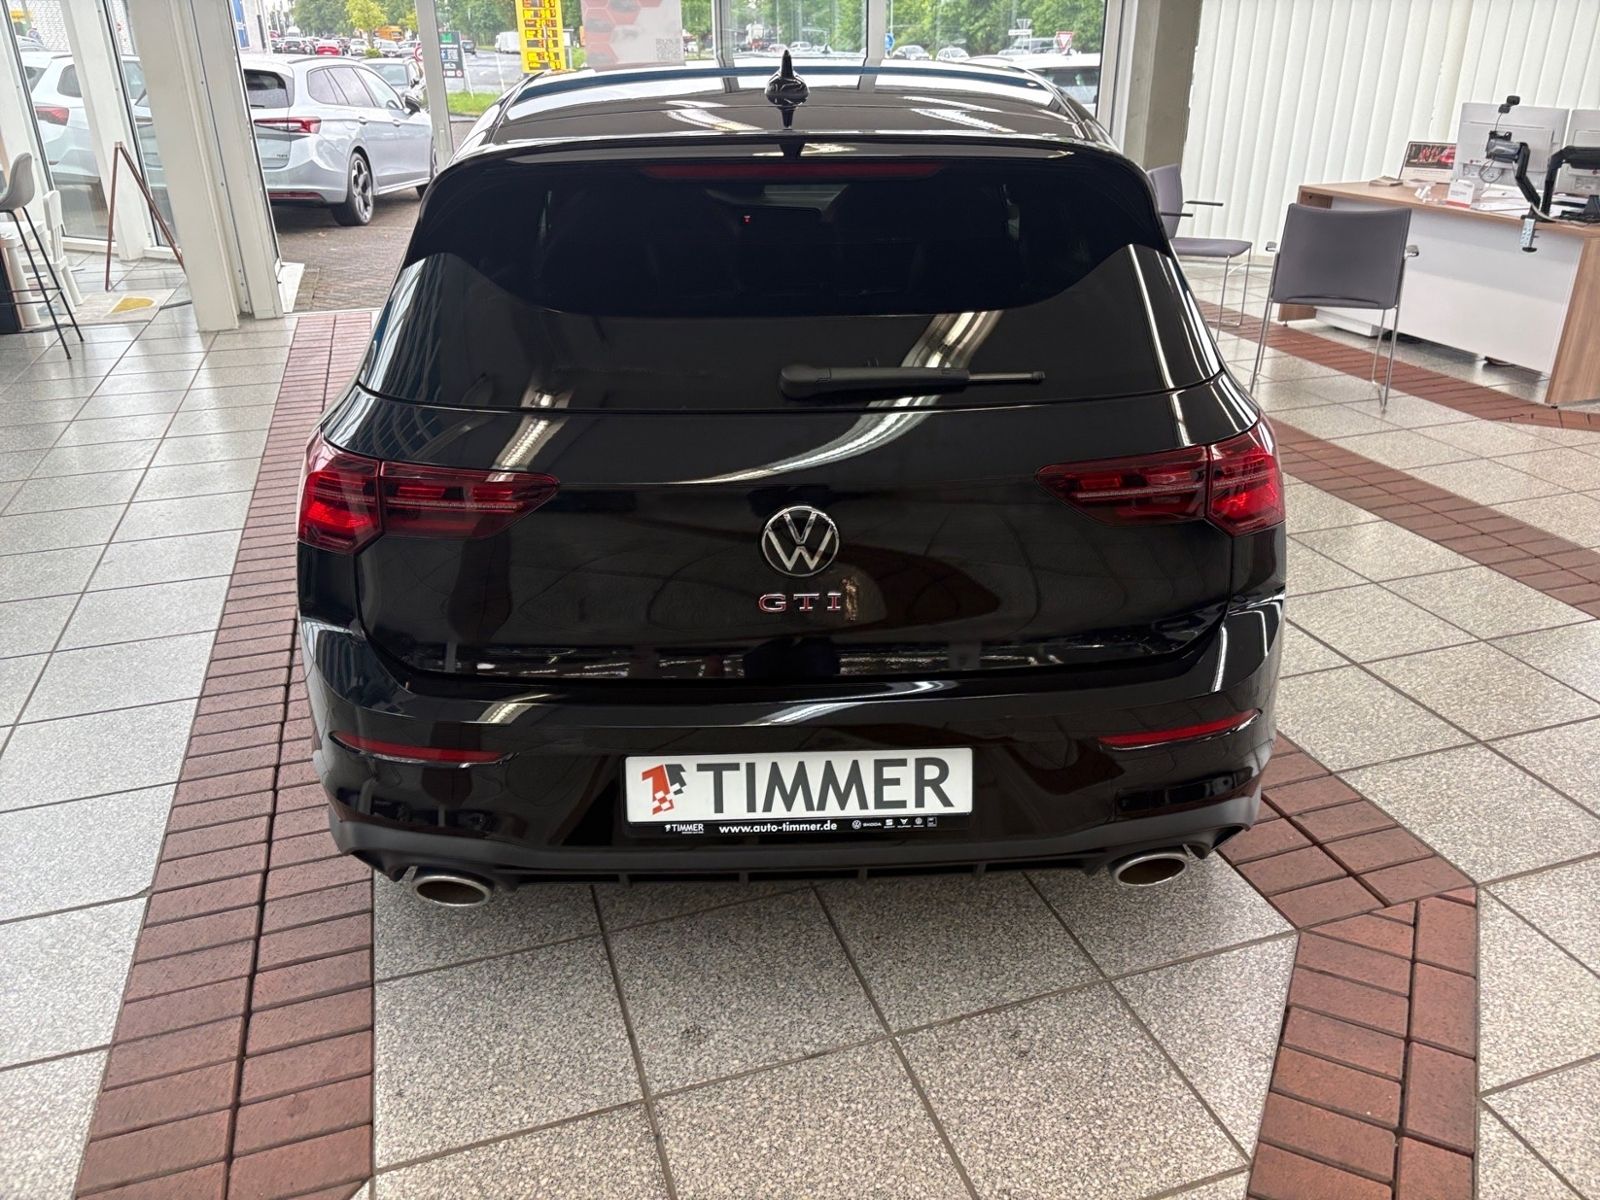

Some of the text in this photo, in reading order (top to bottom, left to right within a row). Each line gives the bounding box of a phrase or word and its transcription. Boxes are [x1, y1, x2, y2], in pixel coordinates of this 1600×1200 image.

[763, 507, 838, 576] VW
[758, 592, 842, 612] GTI
[696, 757, 955, 814] TIMMER
[671, 823, 705, 832] TIMMER
[718, 819, 838, 834] www.auto-timmer.de
